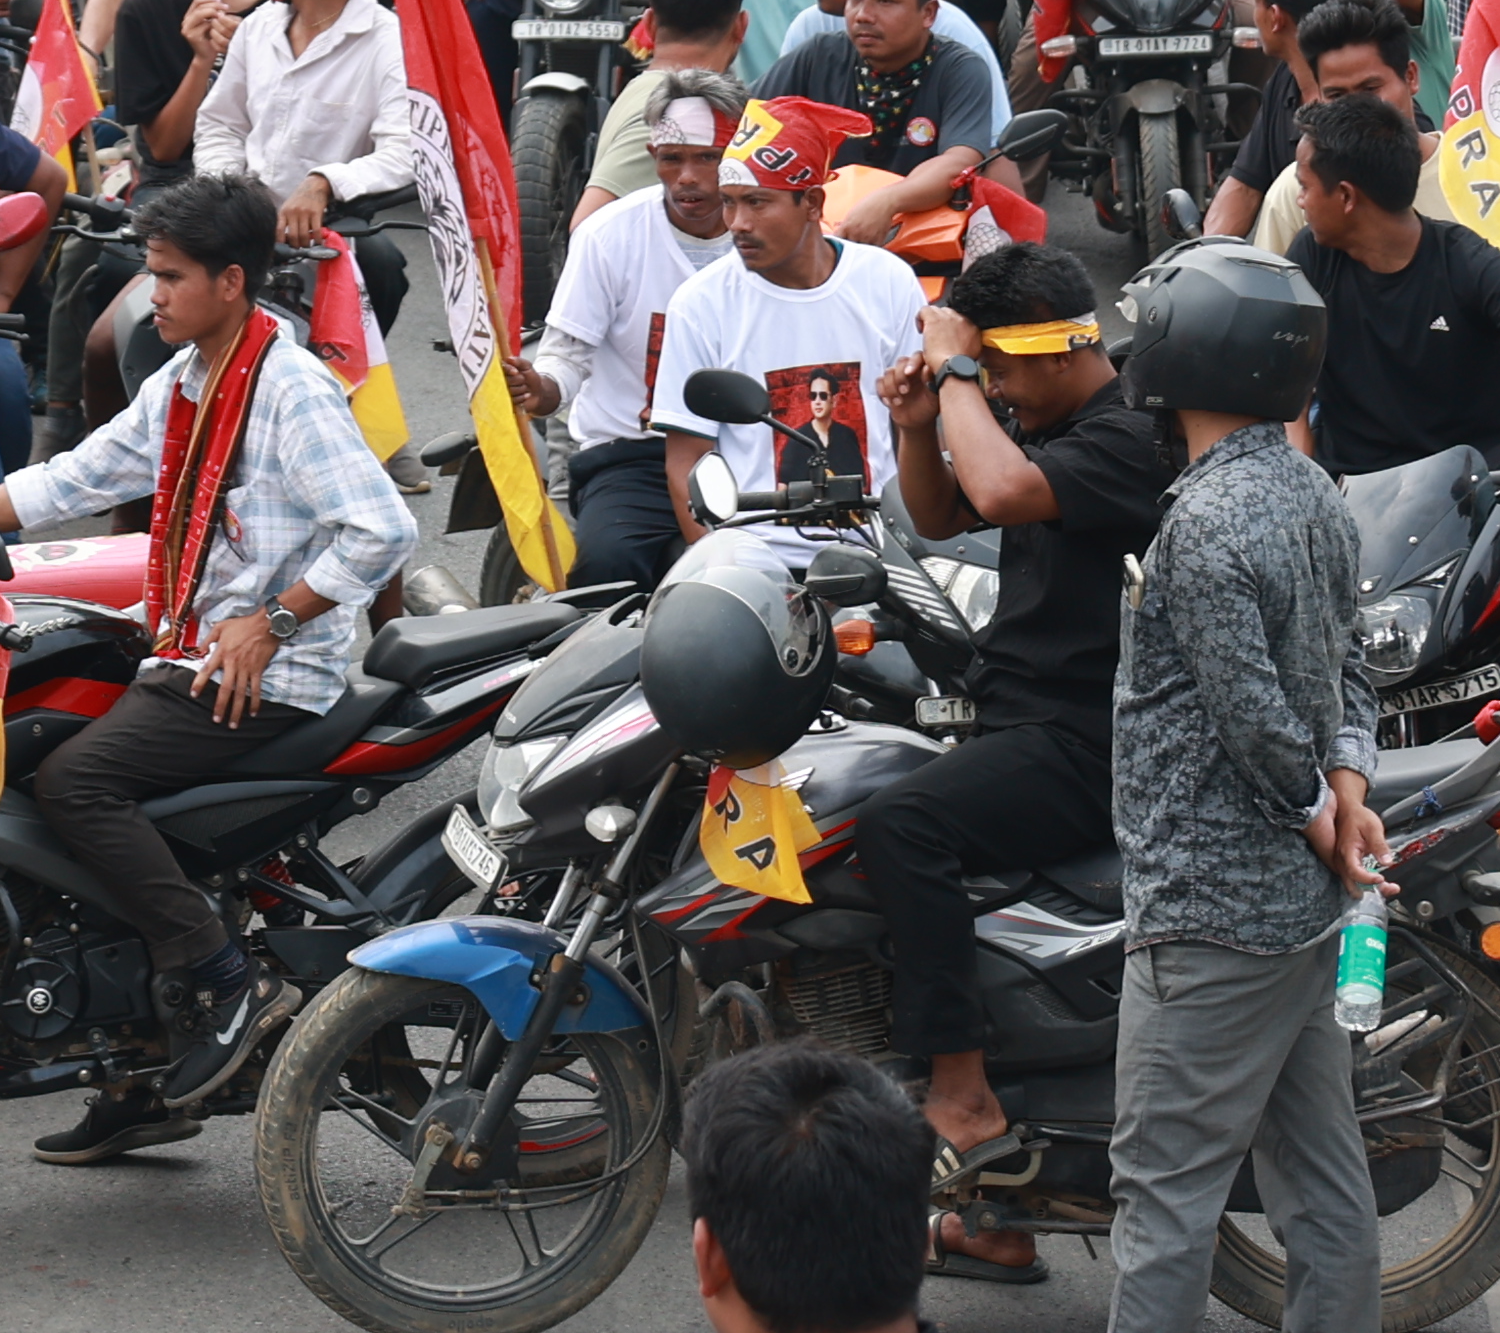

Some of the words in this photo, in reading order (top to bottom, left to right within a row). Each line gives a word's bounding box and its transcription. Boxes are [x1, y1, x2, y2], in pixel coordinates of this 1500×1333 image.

[1393, 684, 1441, 712] 01AR
[1447, 668, 1499, 700] 5715
[948, 699, 974, 721] TR
